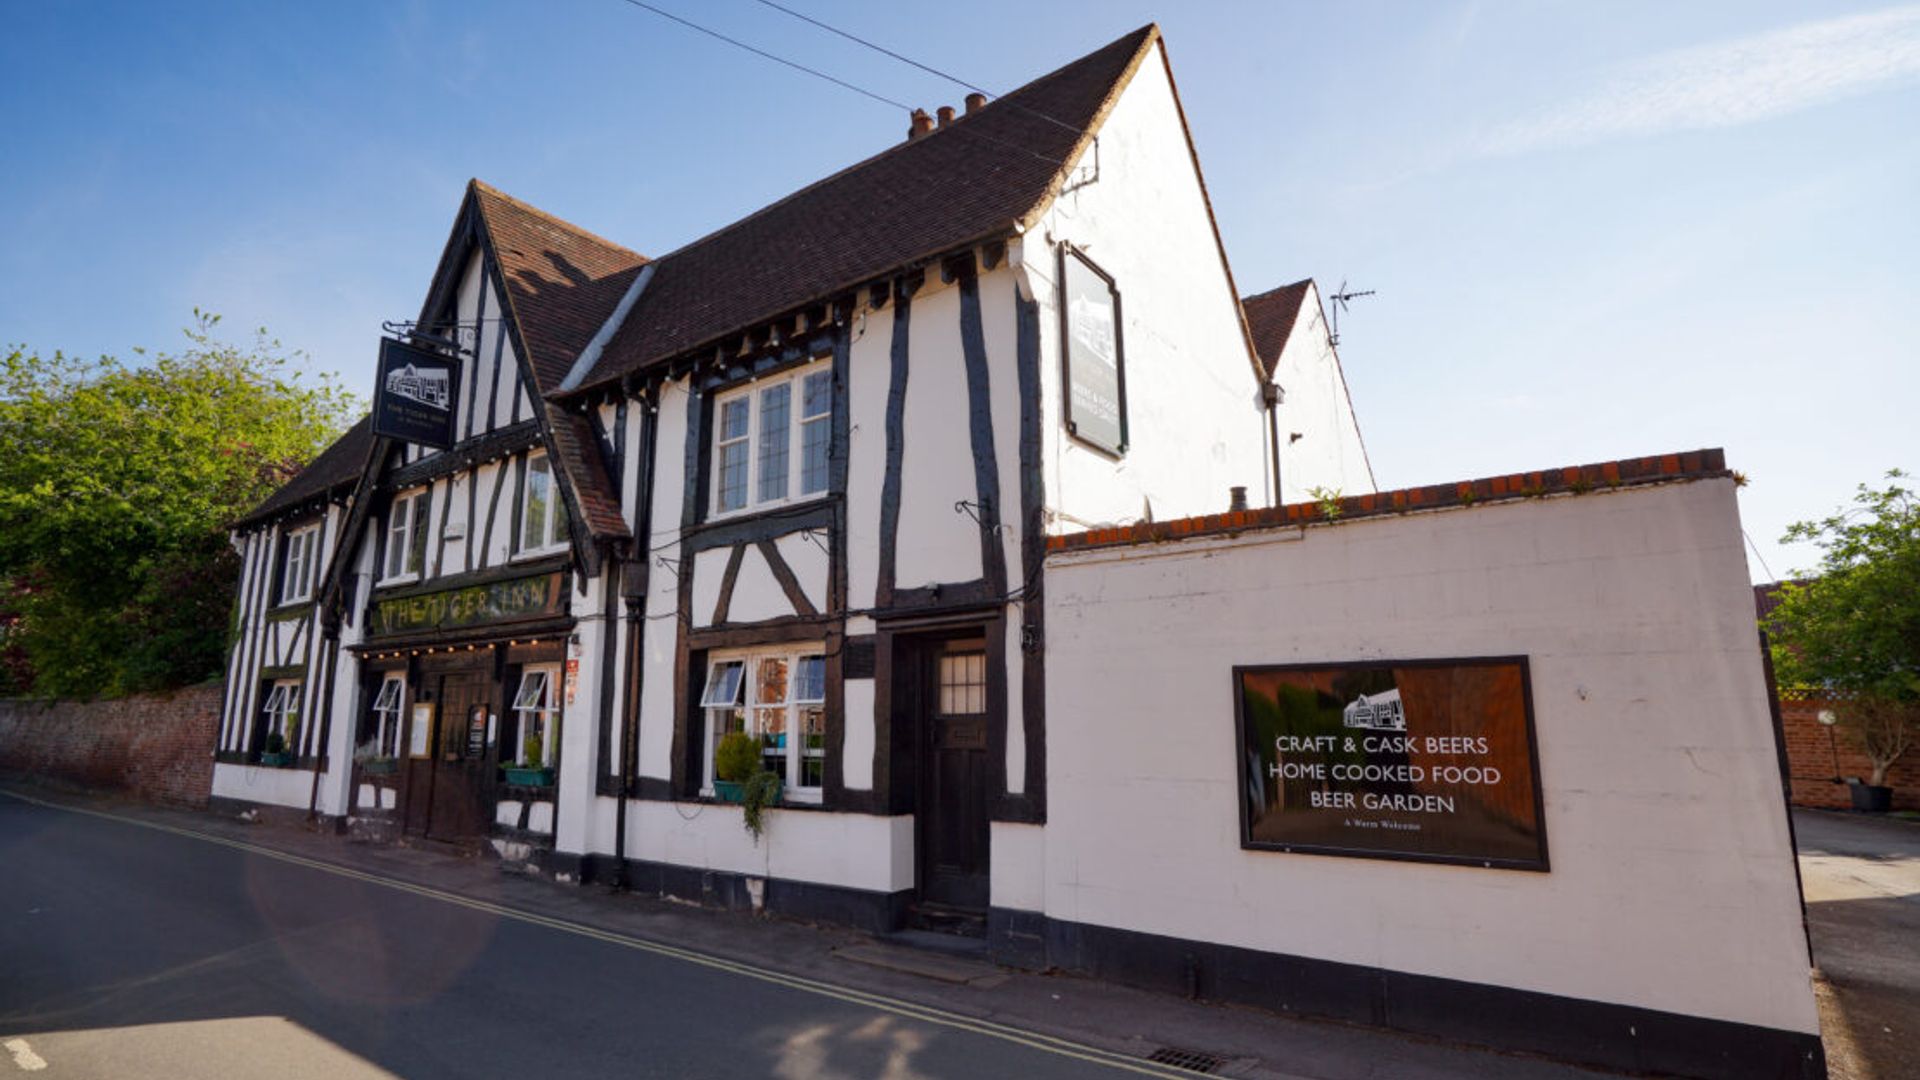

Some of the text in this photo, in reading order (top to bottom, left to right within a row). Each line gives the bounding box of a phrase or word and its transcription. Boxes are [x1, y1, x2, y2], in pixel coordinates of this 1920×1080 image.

[380, 582, 545, 634] THE TIGER INN
[1276, 735, 1488, 754] CRAFT & CASK BEERS
[1269, 762, 1501, 785] HOME COOKED FOOD
[1310, 790, 1455, 813] BEER GARDEN
[1343, 818, 1351, 827] A
[1353, 819, 1378, 829] Warm
